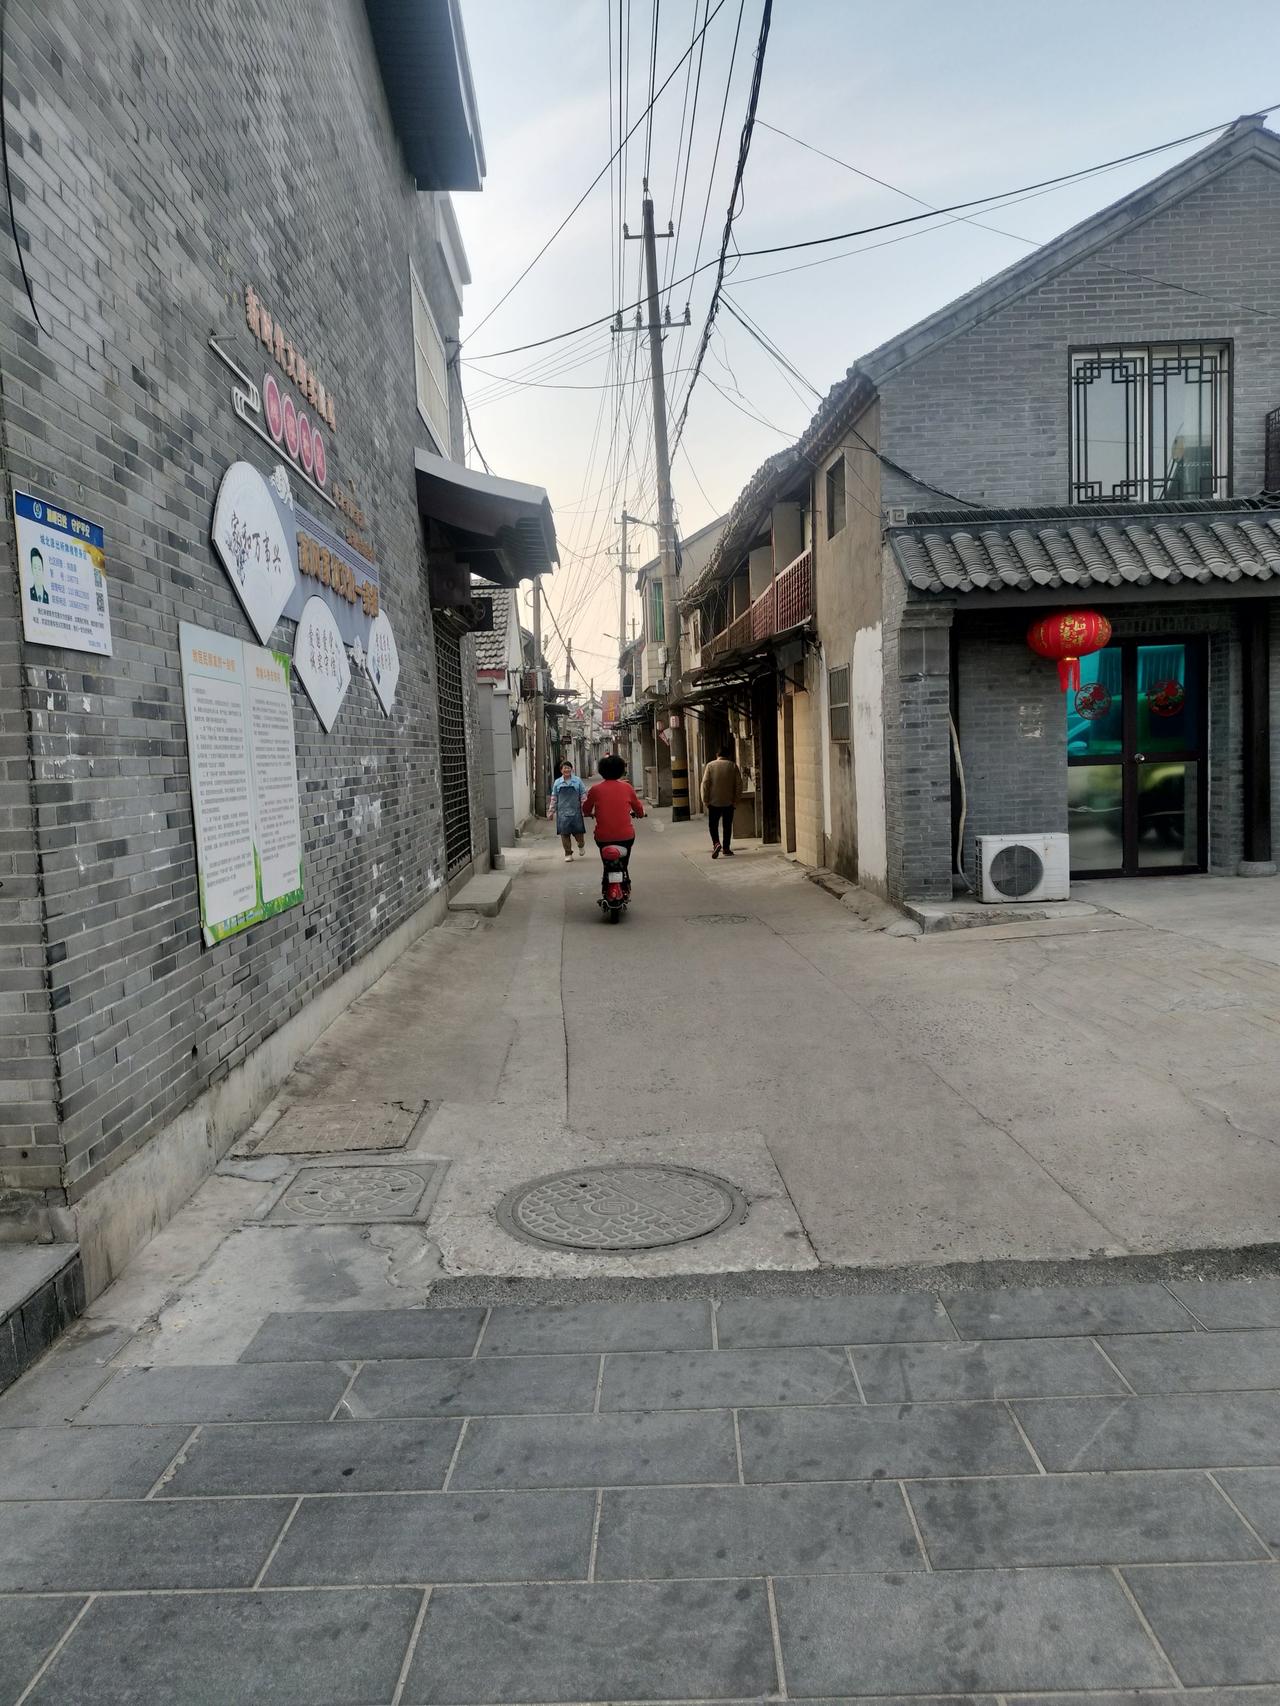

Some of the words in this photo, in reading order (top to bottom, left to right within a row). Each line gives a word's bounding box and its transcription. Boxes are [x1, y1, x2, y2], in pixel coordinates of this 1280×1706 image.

[231, 510, 281, 575] 家和万事兴
